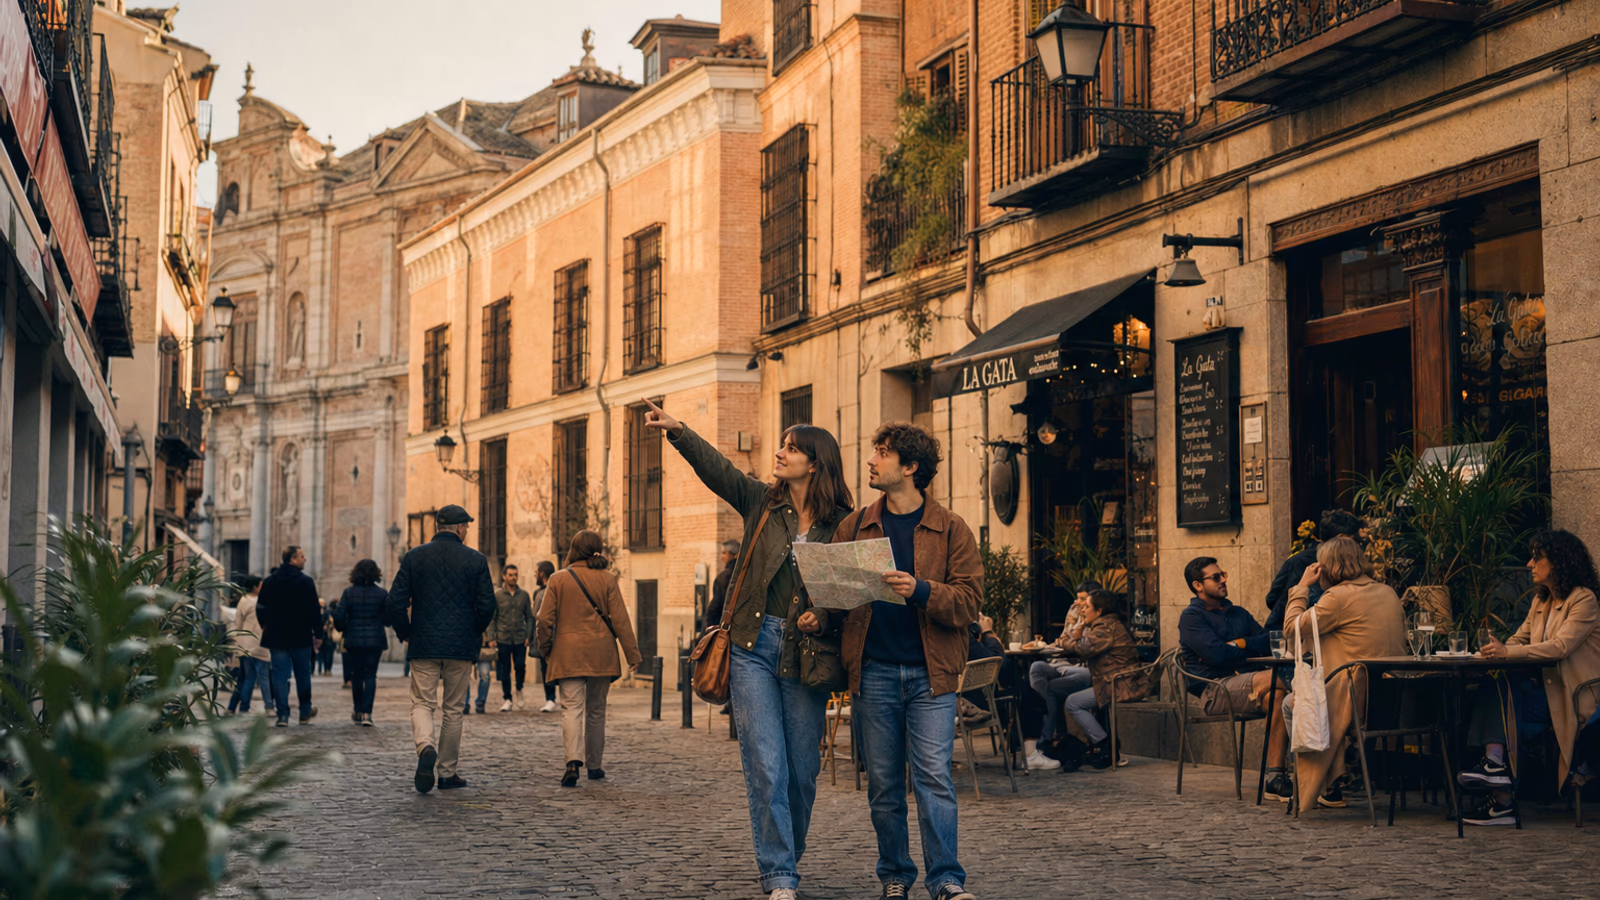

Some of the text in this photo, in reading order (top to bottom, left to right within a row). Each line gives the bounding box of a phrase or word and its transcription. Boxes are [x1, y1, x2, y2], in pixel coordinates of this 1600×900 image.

[962, 365, 981, 391] LA
[982, 357, 1018, 386] GATA
[1181, 357, 1193, 377] La
[1196, 354, 1215, 380] Gata
